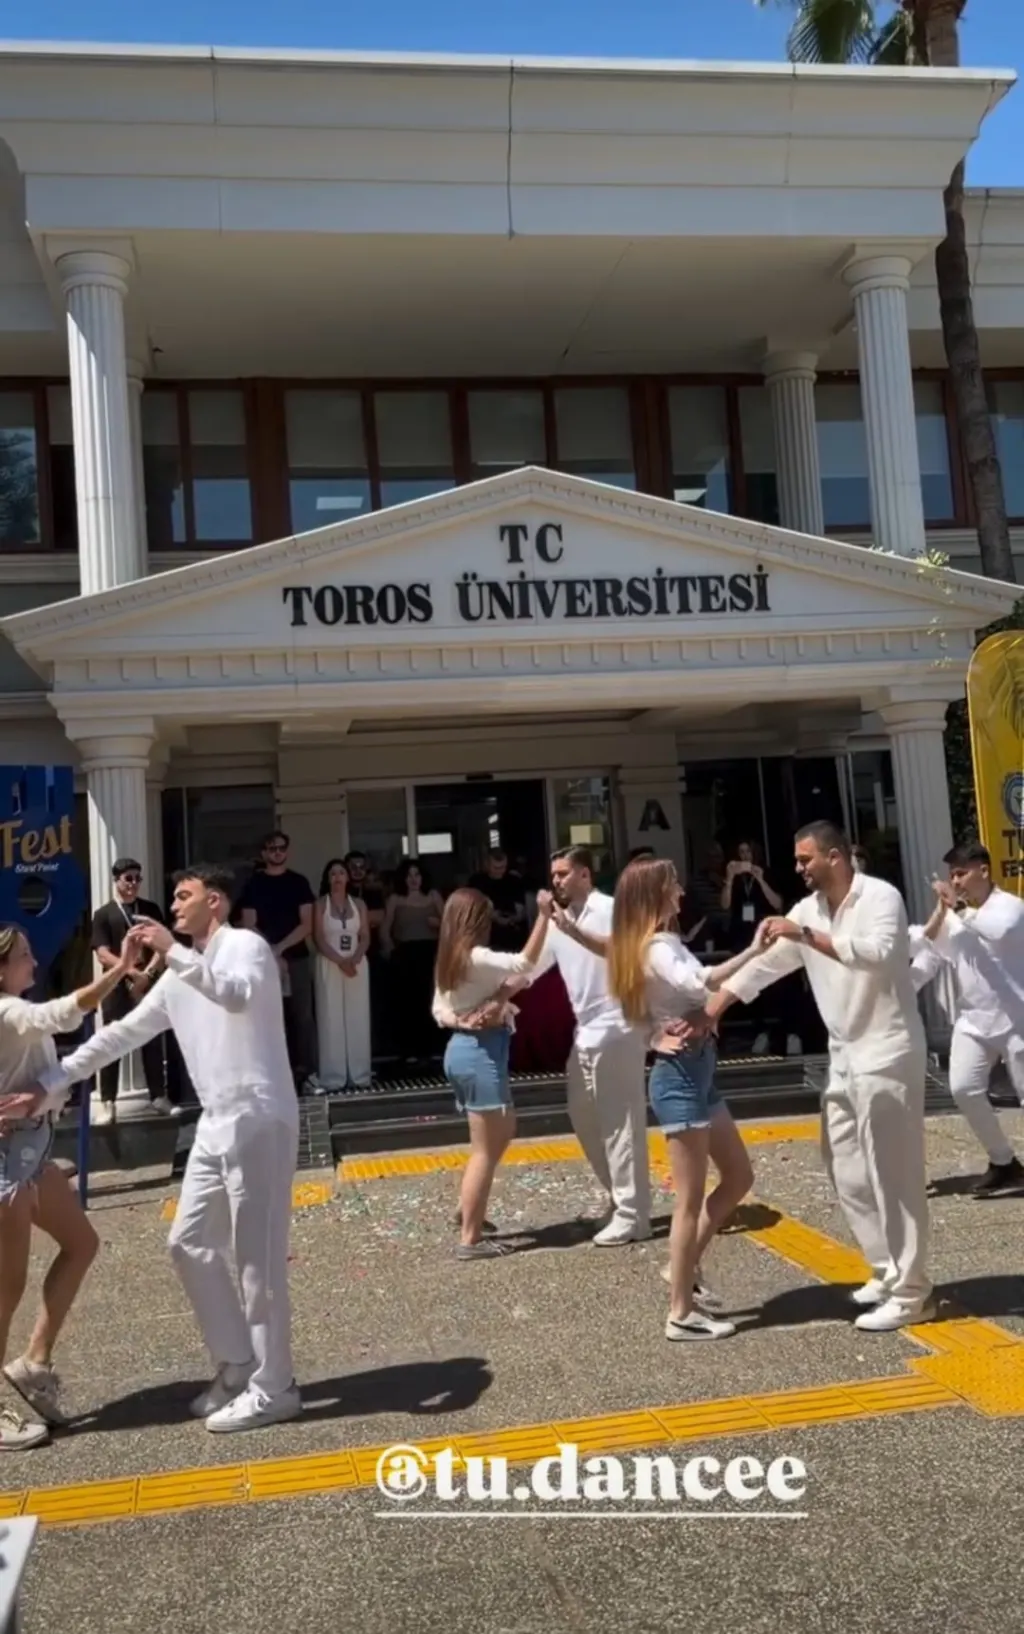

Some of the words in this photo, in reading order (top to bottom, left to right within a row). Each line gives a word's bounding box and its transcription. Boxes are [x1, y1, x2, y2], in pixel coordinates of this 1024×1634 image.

[283, 583, 433, 626] TOROS
[455, 564, 771, 621] ÜNİVERSİTESİ
[0, 814, 73, 868] Fest
[639, 799, 671, 831] A
